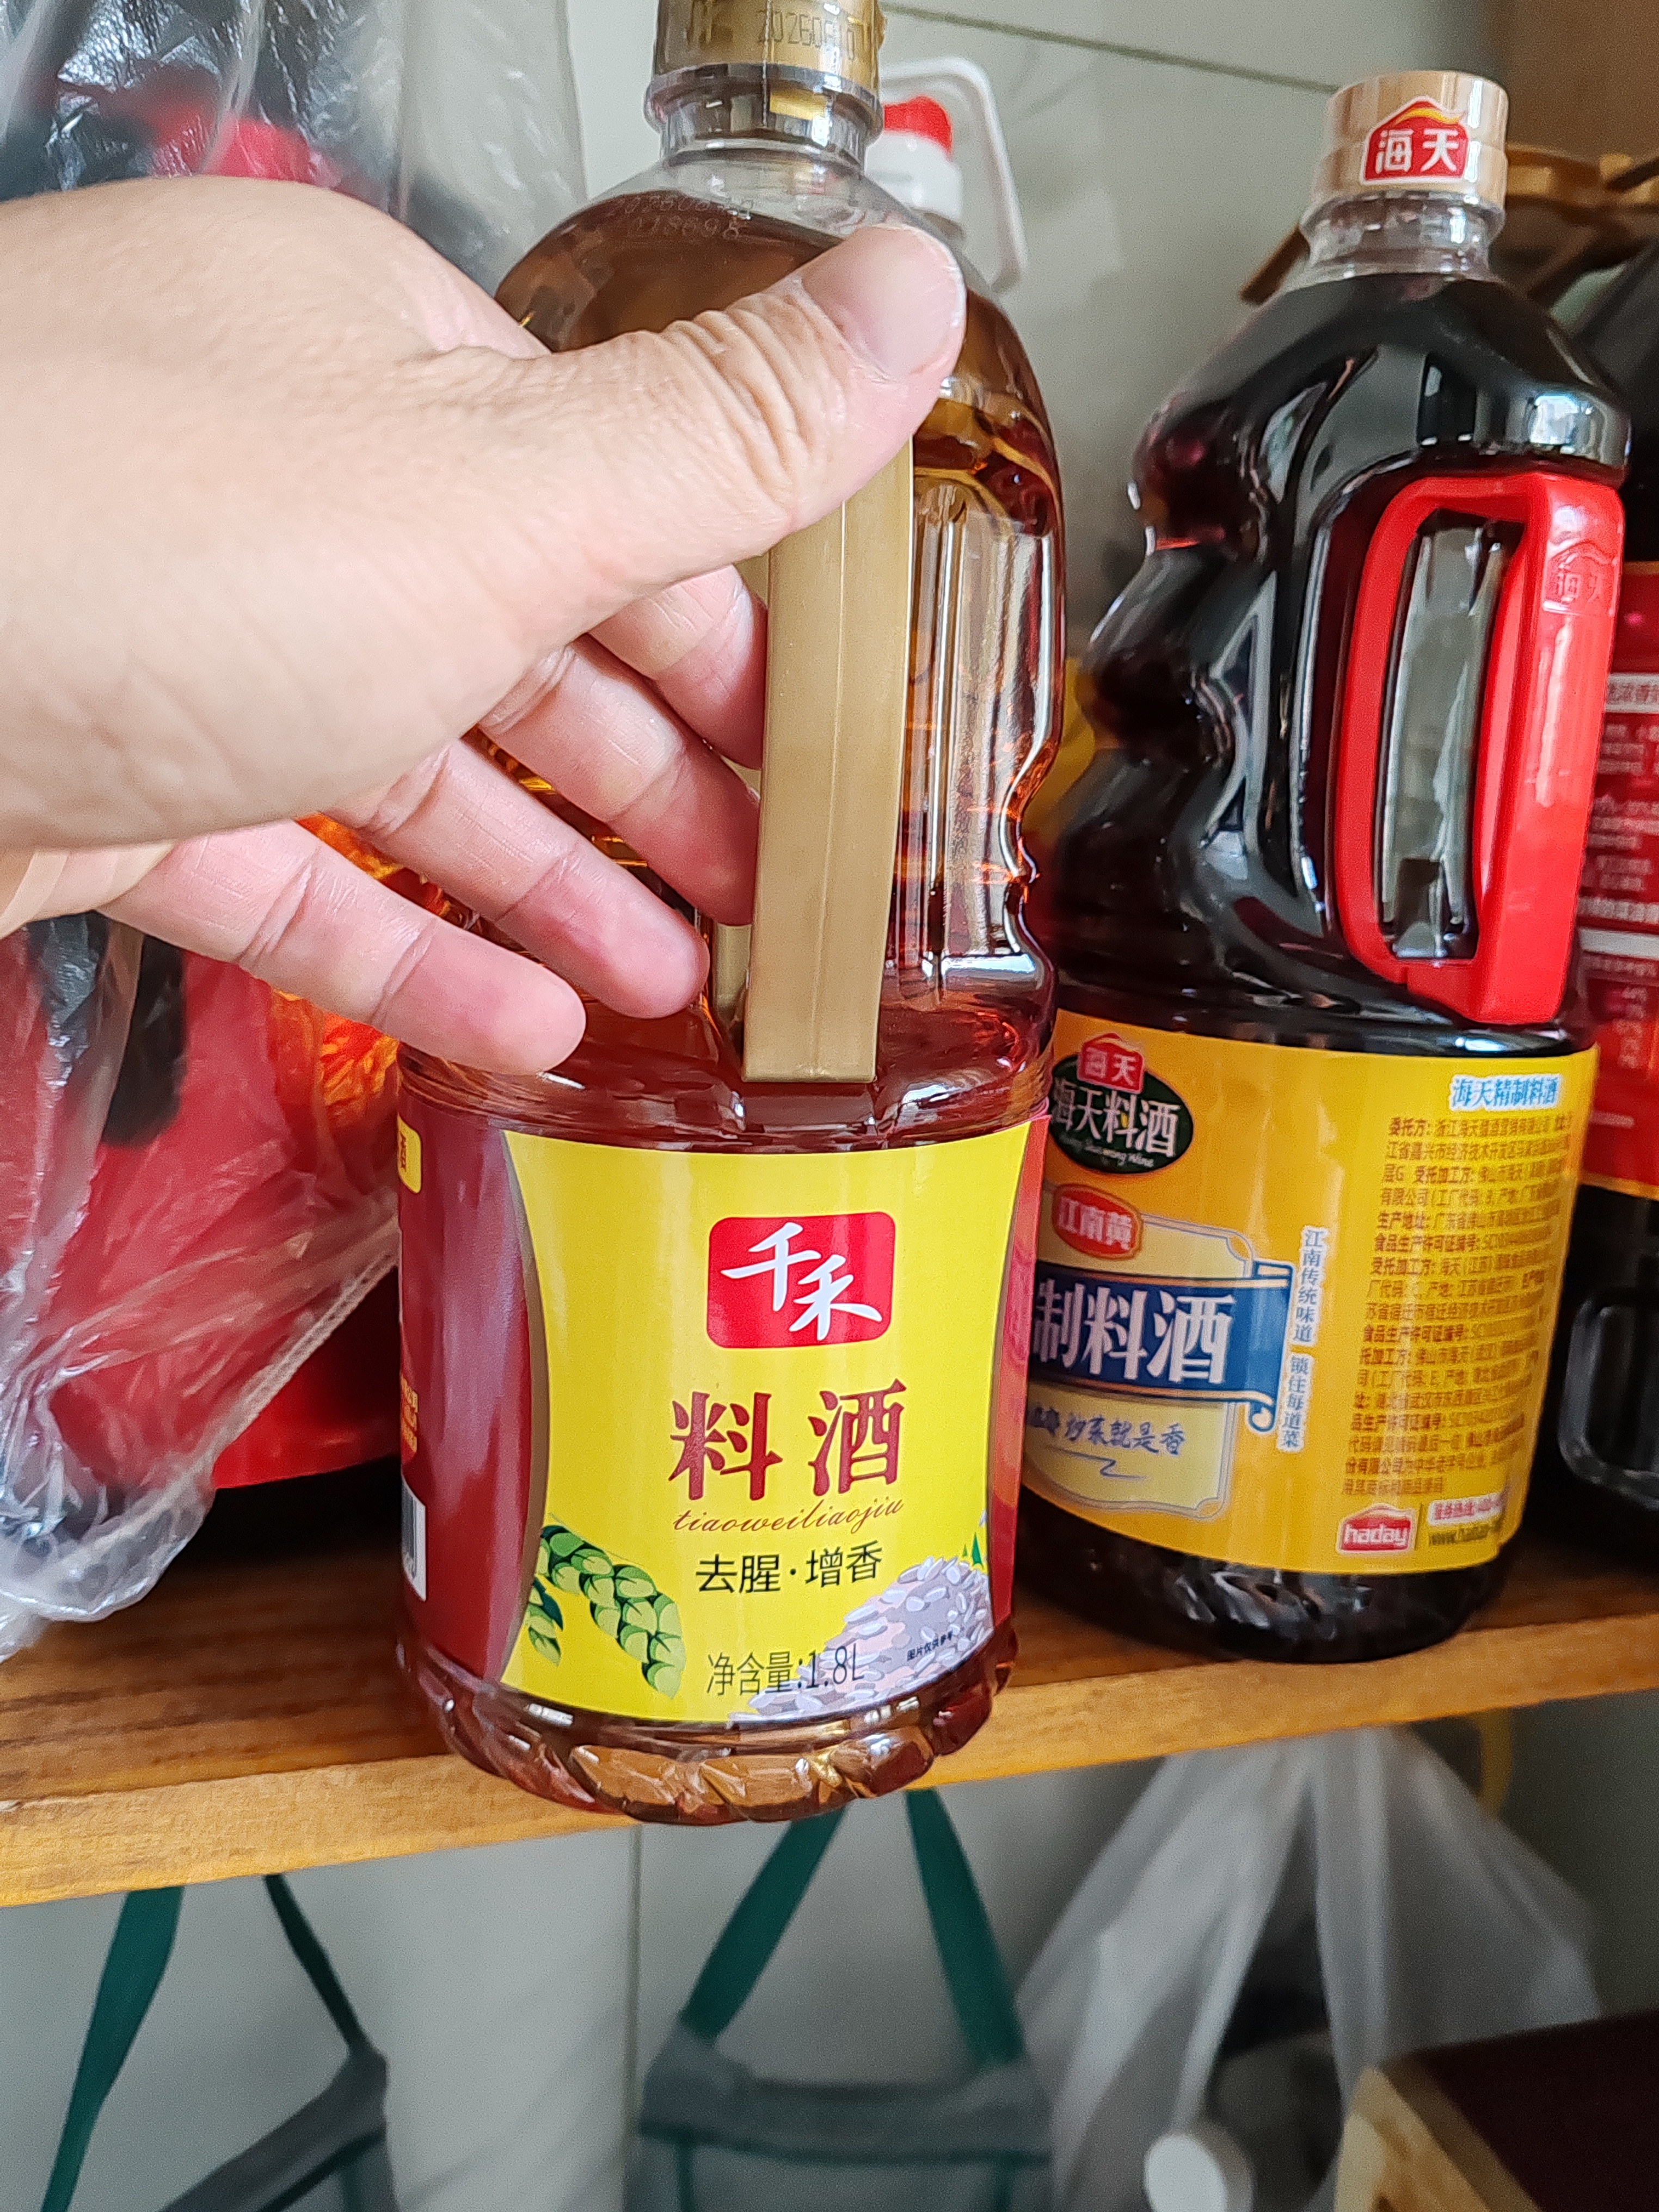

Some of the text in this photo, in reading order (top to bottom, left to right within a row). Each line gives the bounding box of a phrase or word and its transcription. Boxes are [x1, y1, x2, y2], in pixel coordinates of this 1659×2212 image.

[1375, 128, 1460, 174] 海天
[1453, 1076, 1559, 1108] 海天精制料酒
[720, 1221, 883, 1341] 千禾
[1292, 1228, 1325, 1343] 江南传统味道
[1034, 1276, 1237, 1385] 制料酒
[1282, 1356, 1311, 1449] 锁住每道菜
[668, 1378, 907, 1501] 料酒
[673, 1495, 904, 1534] tiaoweiliaojiu
[1344, 1524, 1409, 1546] haday
[695, 1540, 883, 1594] 去腥·增香
[706, 1642, 865, 1697] 净含量:1.8L
